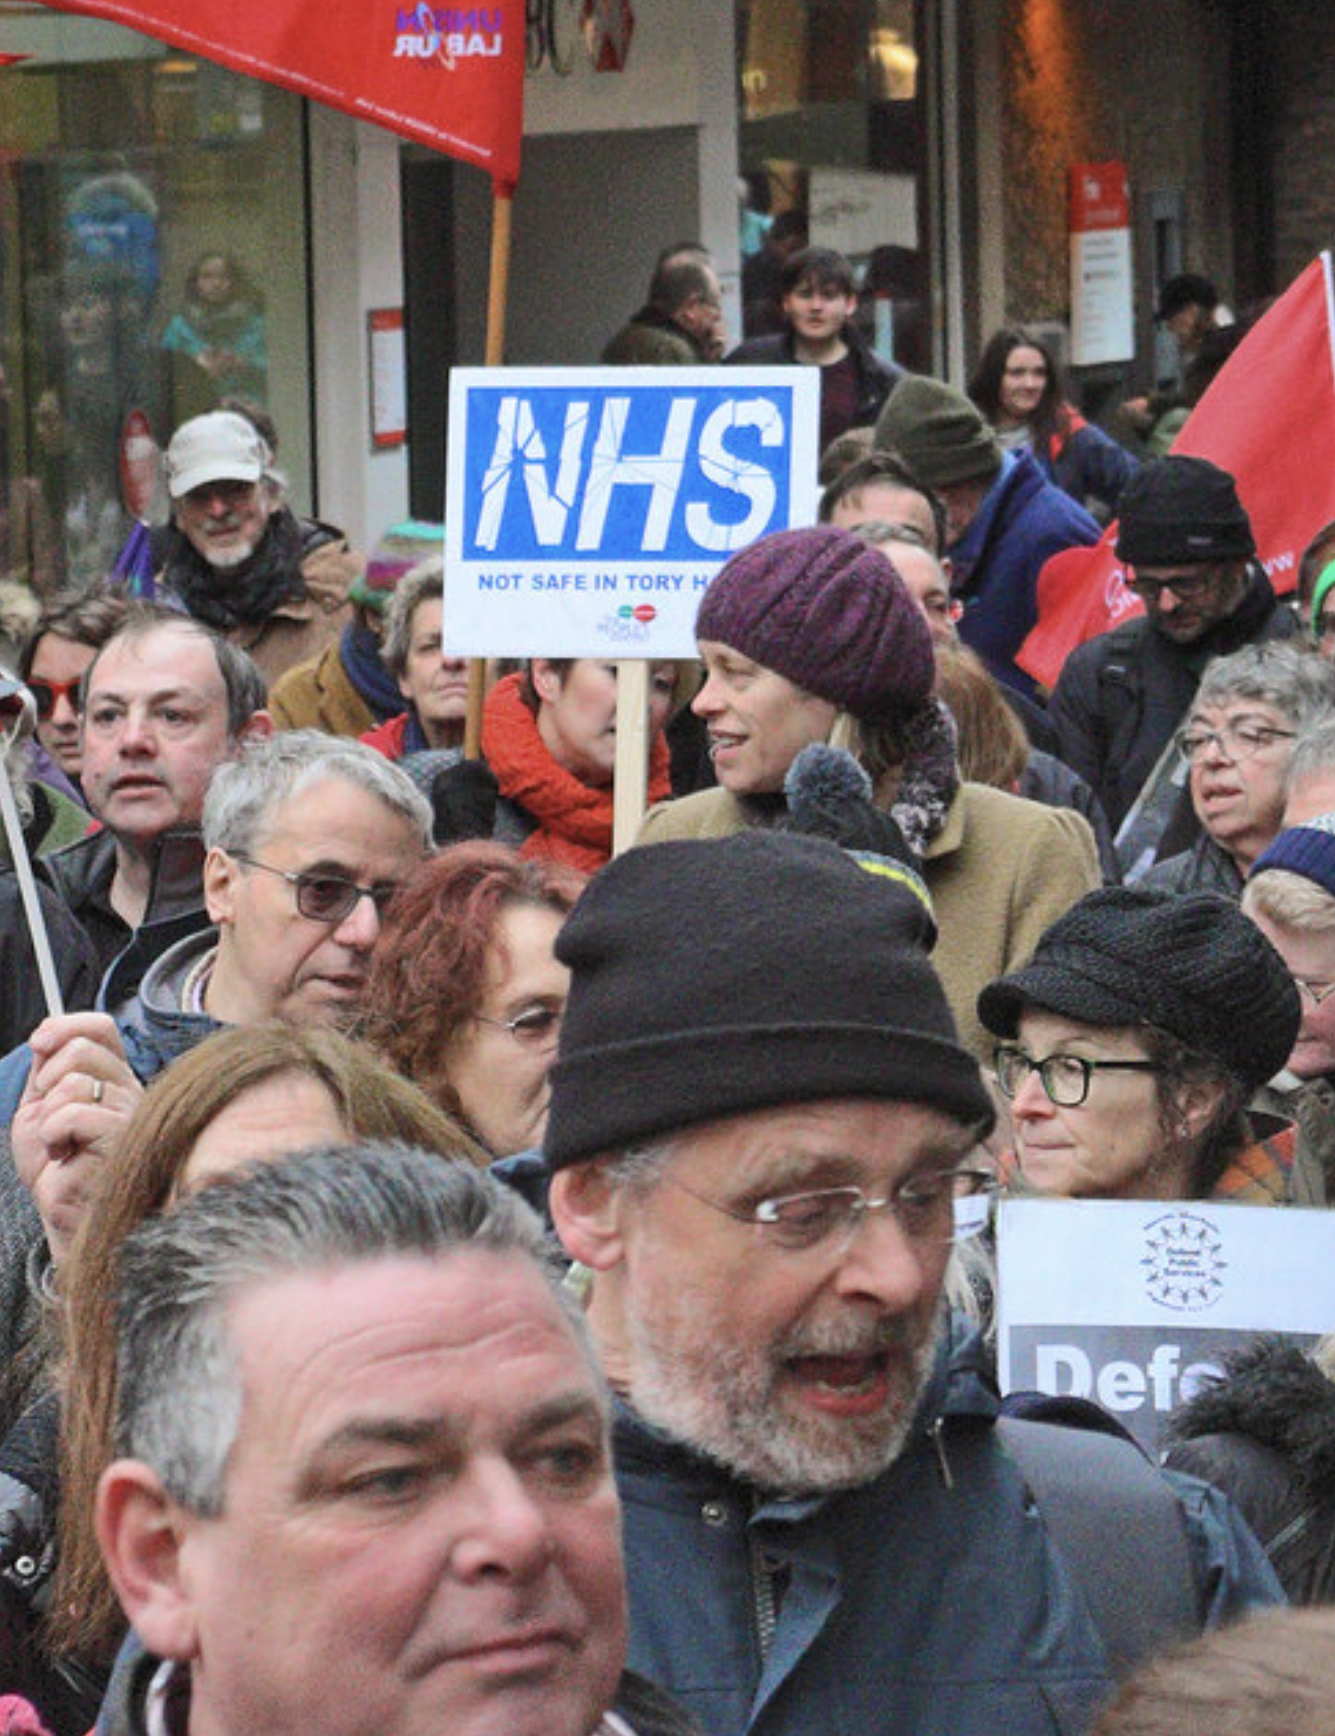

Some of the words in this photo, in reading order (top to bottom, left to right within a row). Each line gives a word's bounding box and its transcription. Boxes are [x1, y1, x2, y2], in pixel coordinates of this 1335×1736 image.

[474, 396, 785, 551] NHS
[478, 574, 524, 591] NOT
[530, 574, 588, 591] SAFE
[594, 574, 618, 591] IN
[625, 574, 684, 591] TORY
